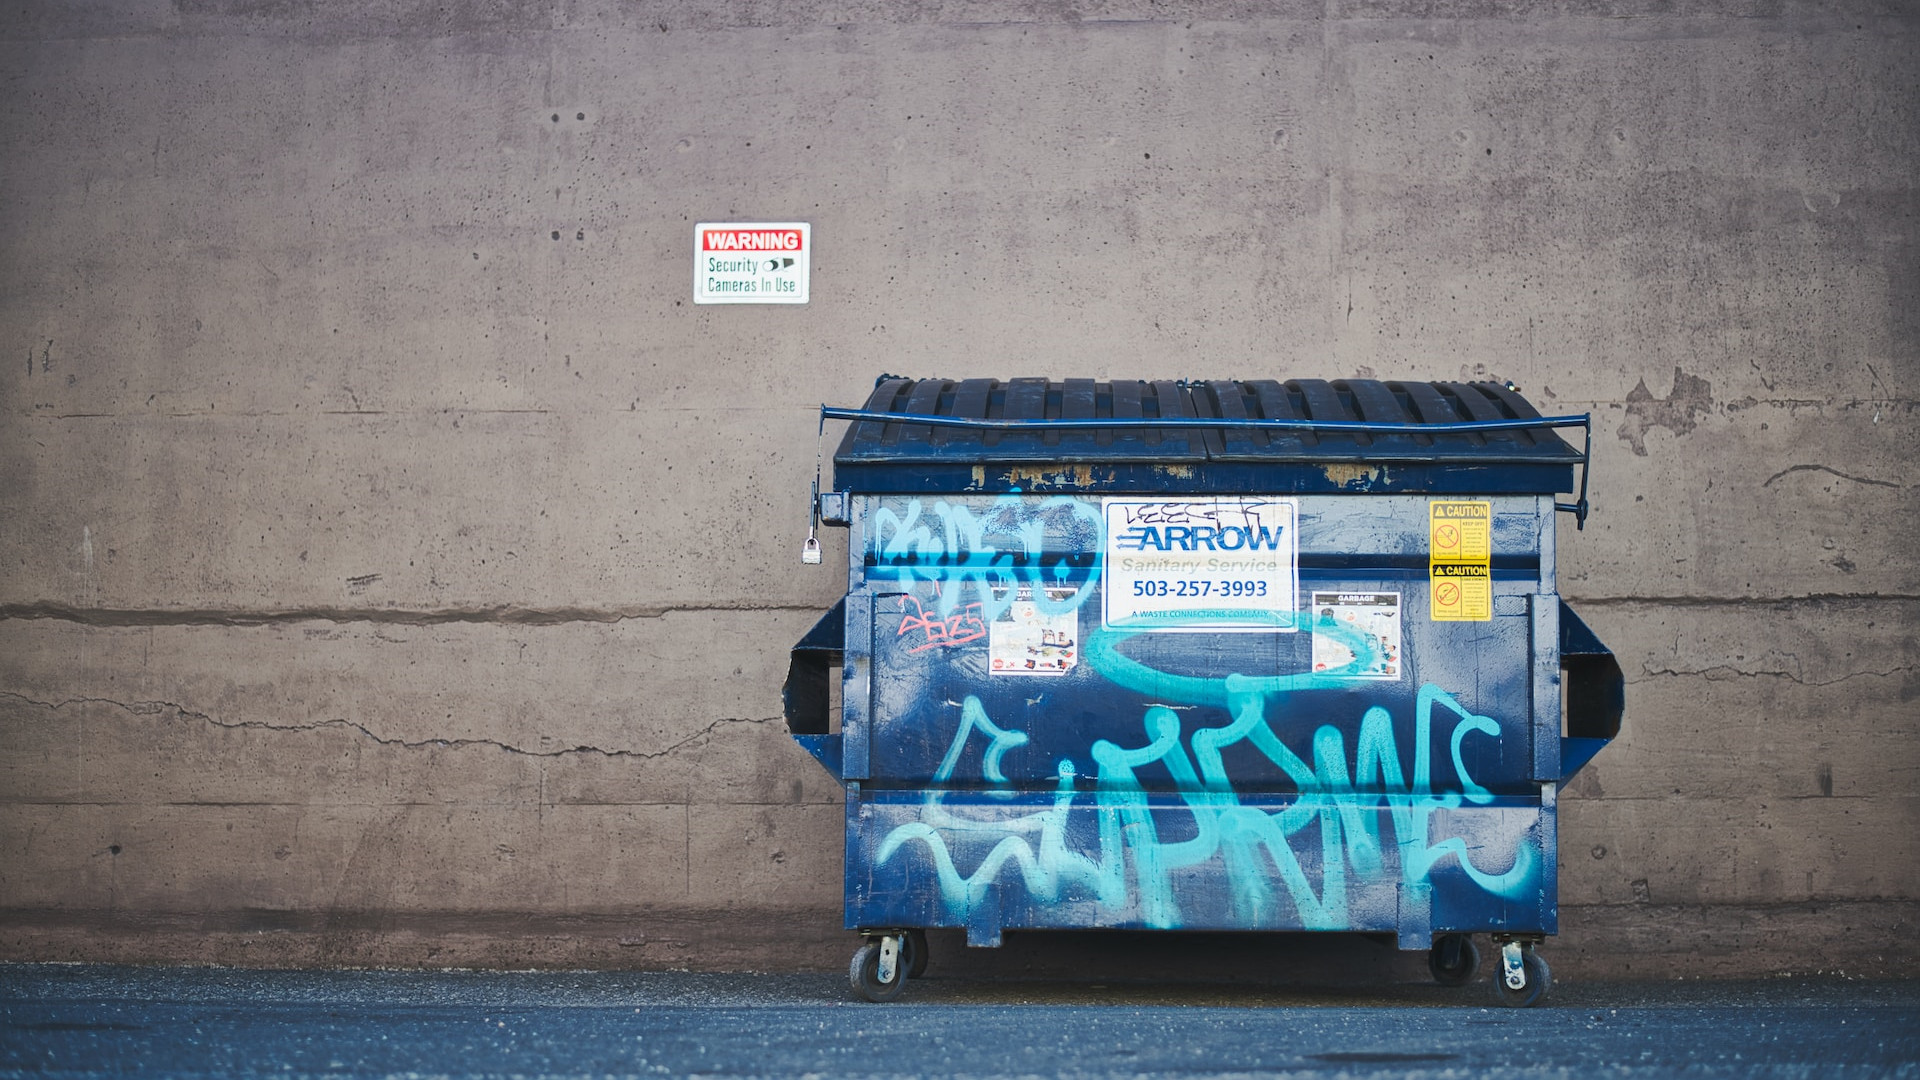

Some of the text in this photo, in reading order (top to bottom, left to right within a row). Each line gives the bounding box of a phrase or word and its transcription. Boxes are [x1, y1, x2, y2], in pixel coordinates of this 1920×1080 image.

[707, 232, 799, 250] WARNING
[708, 257, 759, 275] Security
[708, 277, 796, 292] Cameras In Use
[1446, 505, 1487, 517] CAUTION
[1137, 526, 1284, 551] ARROW
[1121, 558, 1277, 573] Sanitary Service
[1446, 566, 1487, 576] CAUTION
[1133, 580, 1268, 597] 503-257-3993
[1140, 610, 1168, 618] WASTE
[1169, 610, 1226, 618] CONNECTIONS
